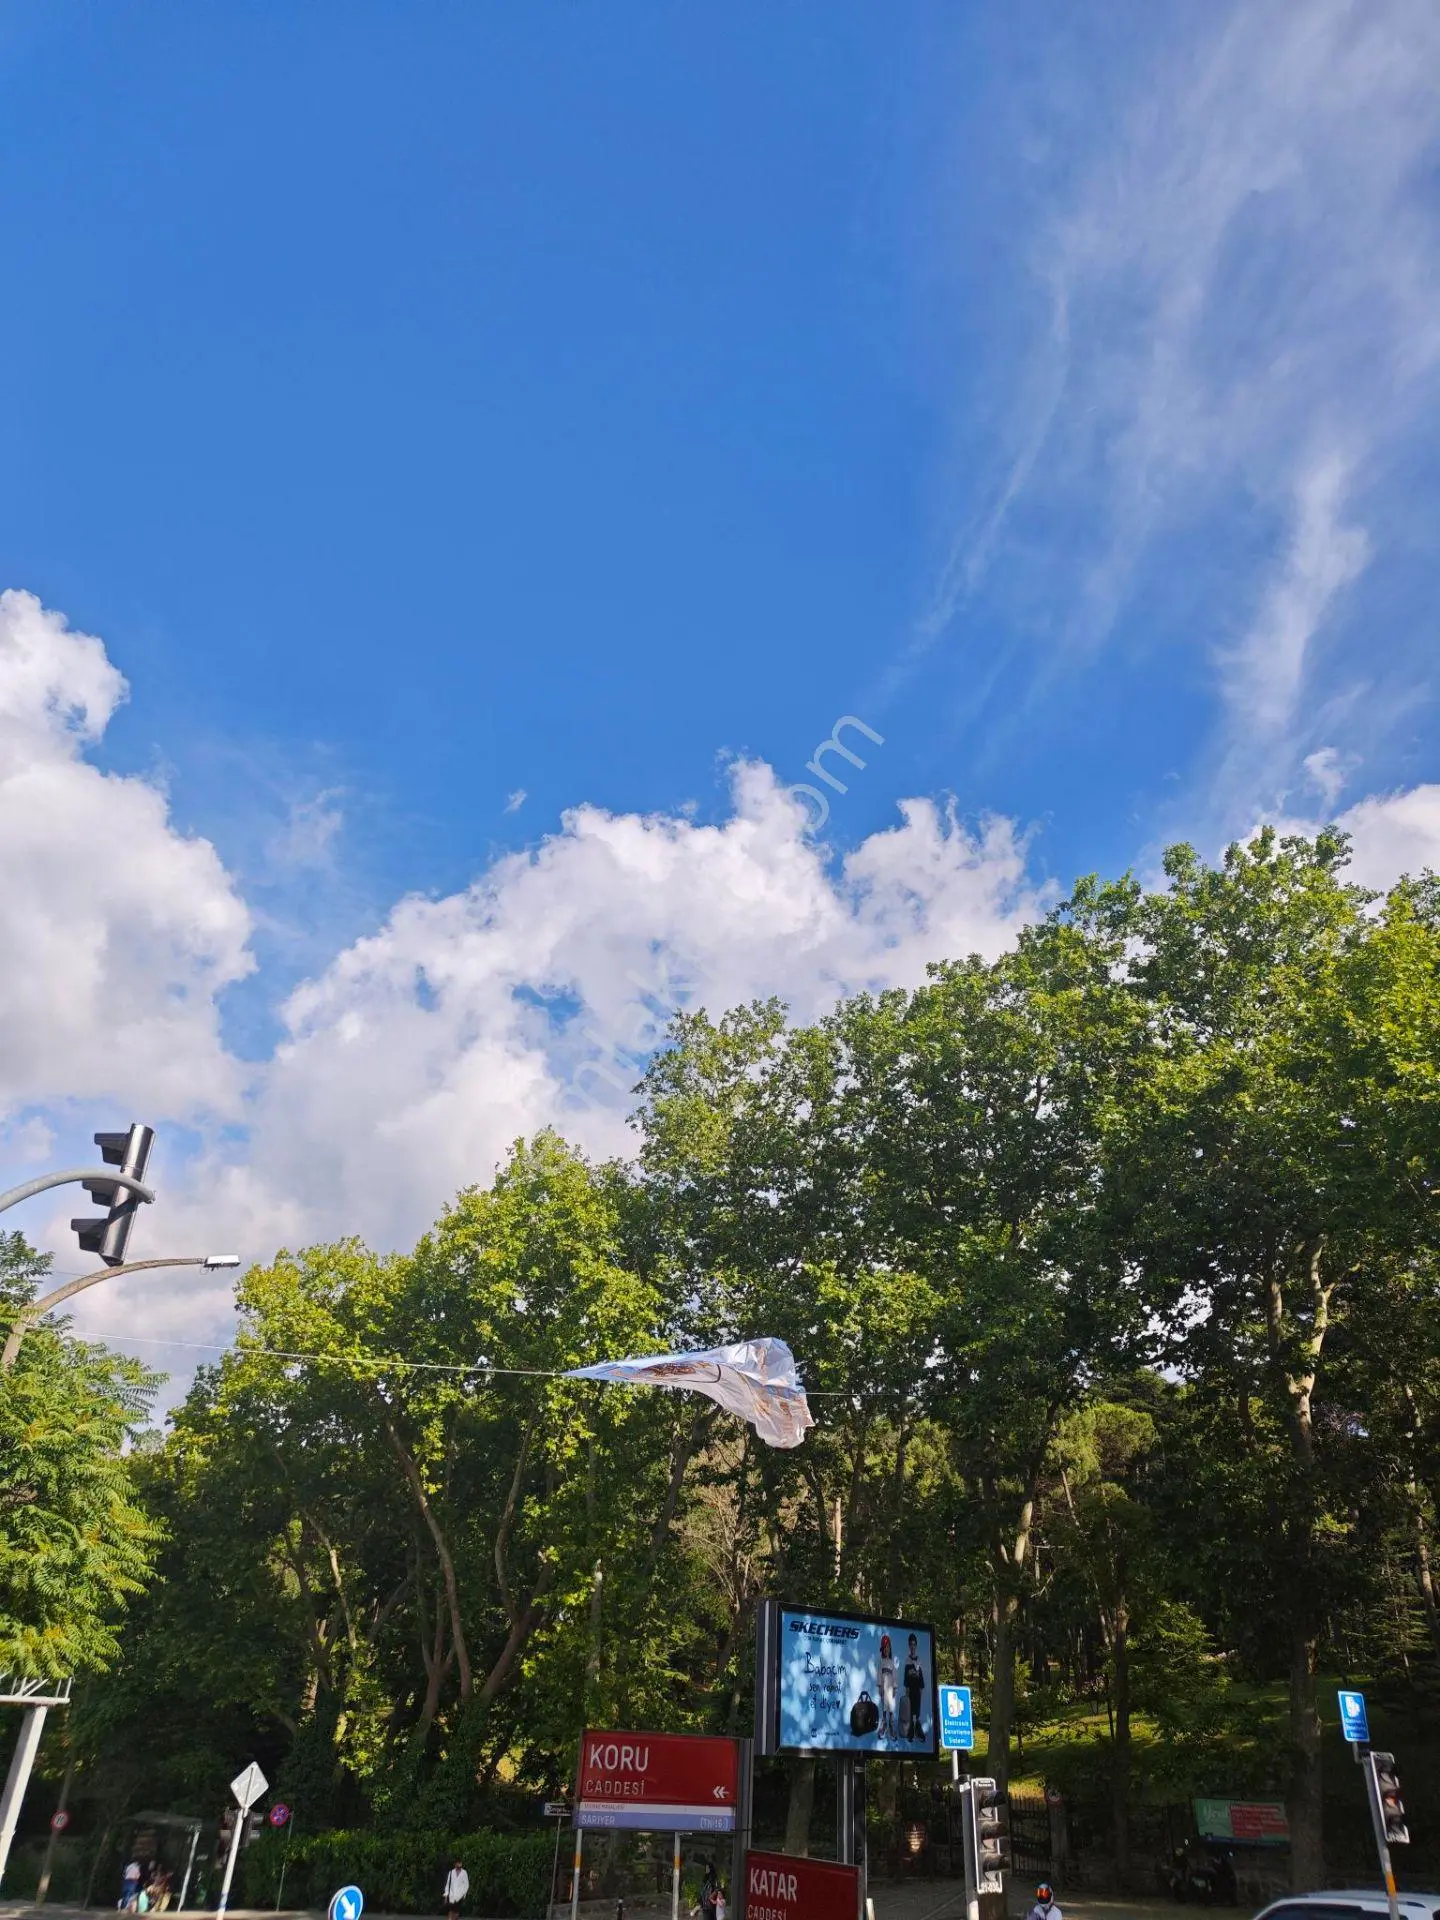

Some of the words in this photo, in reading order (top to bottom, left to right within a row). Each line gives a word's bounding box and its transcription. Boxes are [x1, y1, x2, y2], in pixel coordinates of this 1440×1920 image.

[788, 1620, 861, 1640] SKECHERS
[589, 1744, 649, 1772] KORU
[585, 1779, 645, 1796] CADDESİ
[750, 1867, 798, 1903] KATAR
[746, 1904, 788, 1920] CADDESİ
